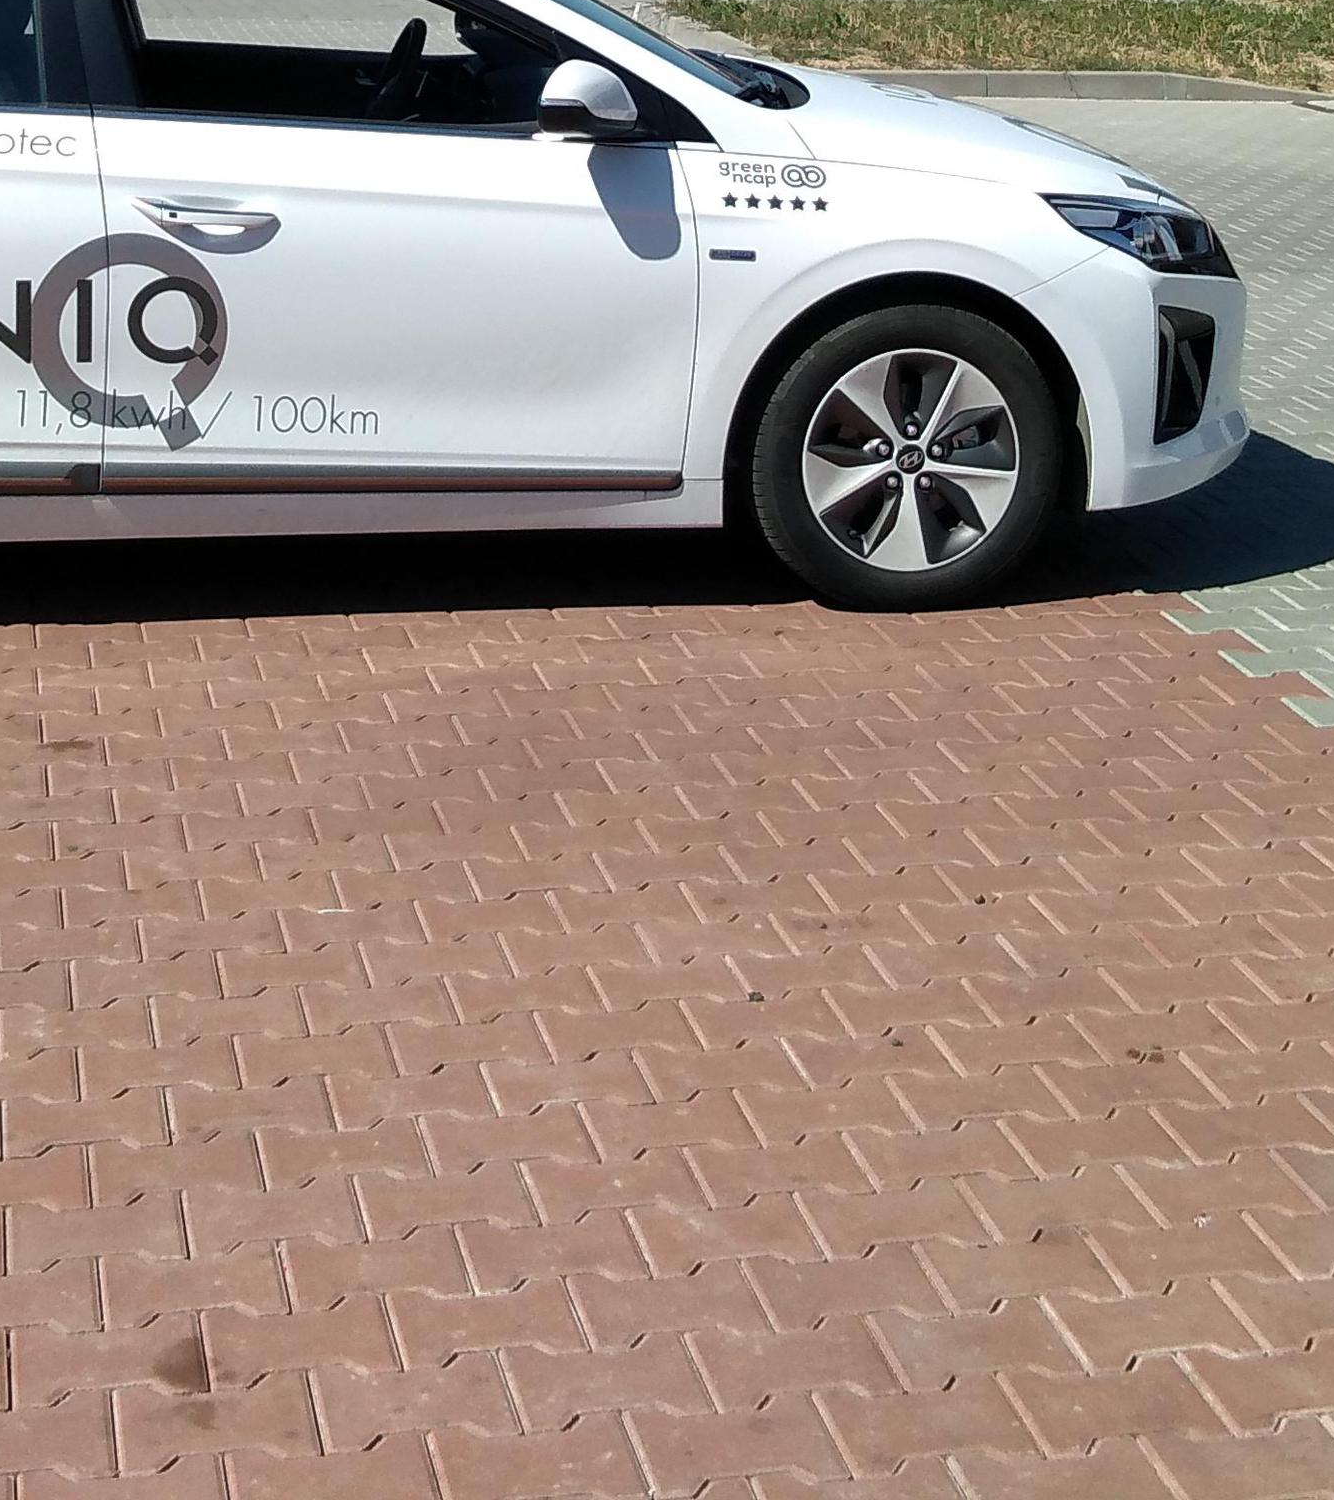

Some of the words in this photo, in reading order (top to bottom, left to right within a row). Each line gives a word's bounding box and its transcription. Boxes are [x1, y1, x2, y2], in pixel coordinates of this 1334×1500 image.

[719, 161, 775, 176] green
[733, 173, 776, 187] ncap
[16, 390, 93, 436] 11,8
[112, 389, 188, 430] kwh
[253, 394, 379, 436] 100km
